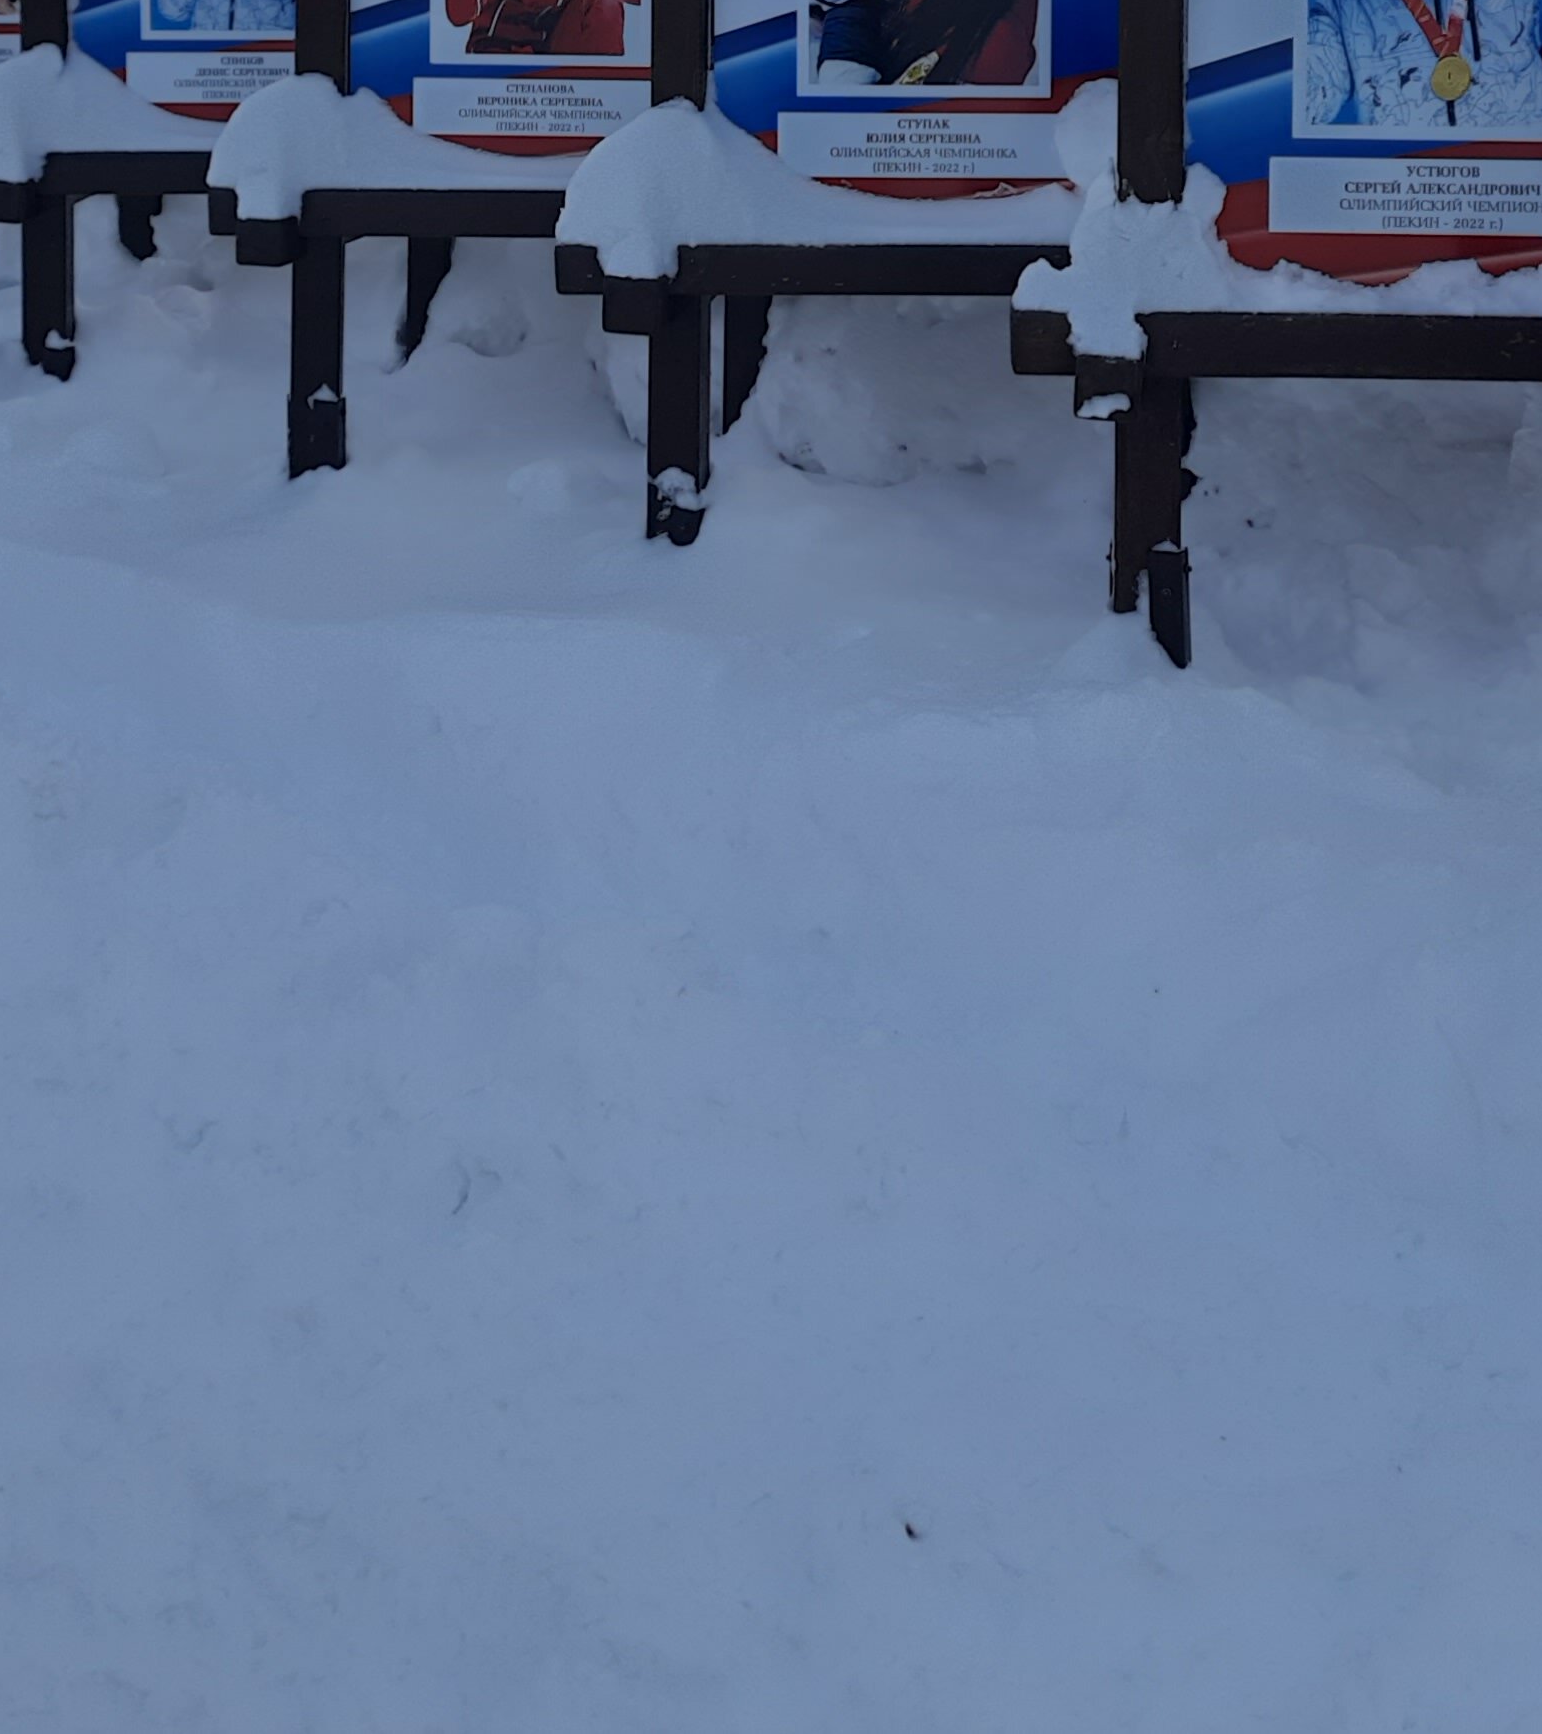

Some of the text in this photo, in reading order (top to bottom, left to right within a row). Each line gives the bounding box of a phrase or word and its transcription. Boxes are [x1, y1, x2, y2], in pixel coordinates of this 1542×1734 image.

[506, 84, 575, 94] СТЕПАНОВА
[477, 96, 603, 107] ВЕРОНИКА СЕРГЕЕВНА
[458, 108, 622, 120] ОЛИМПИЙСКАЯ ЧЕМПИОНКА
[548, 123, 571, 132] 2022
[897, 119, 950, 130] СТУПАК
[866, 133, 981, 144] ЮЛИЯ СЕРГЕЕВНА
[829, 144, 1018, 159] ОЛИМПИЙСКАЯ ЧЕМПИОНКА
[872, 161, 922, 174] (ПЕКИН
[932, 162, 960, 174] 2022
[1406, 165, 1481, 179] УСТЮГОВ
[1344, 179, 1541, 198] СЕРГЕЙ АЛЕКСАНДРОВИЧ
[1339, 196, 1462, 212] ОЛИМПИЙСКИЙ
[1381, 215, 1440, 230] (ПЕКИН
[1453, 218, 1486, 230] 2022
